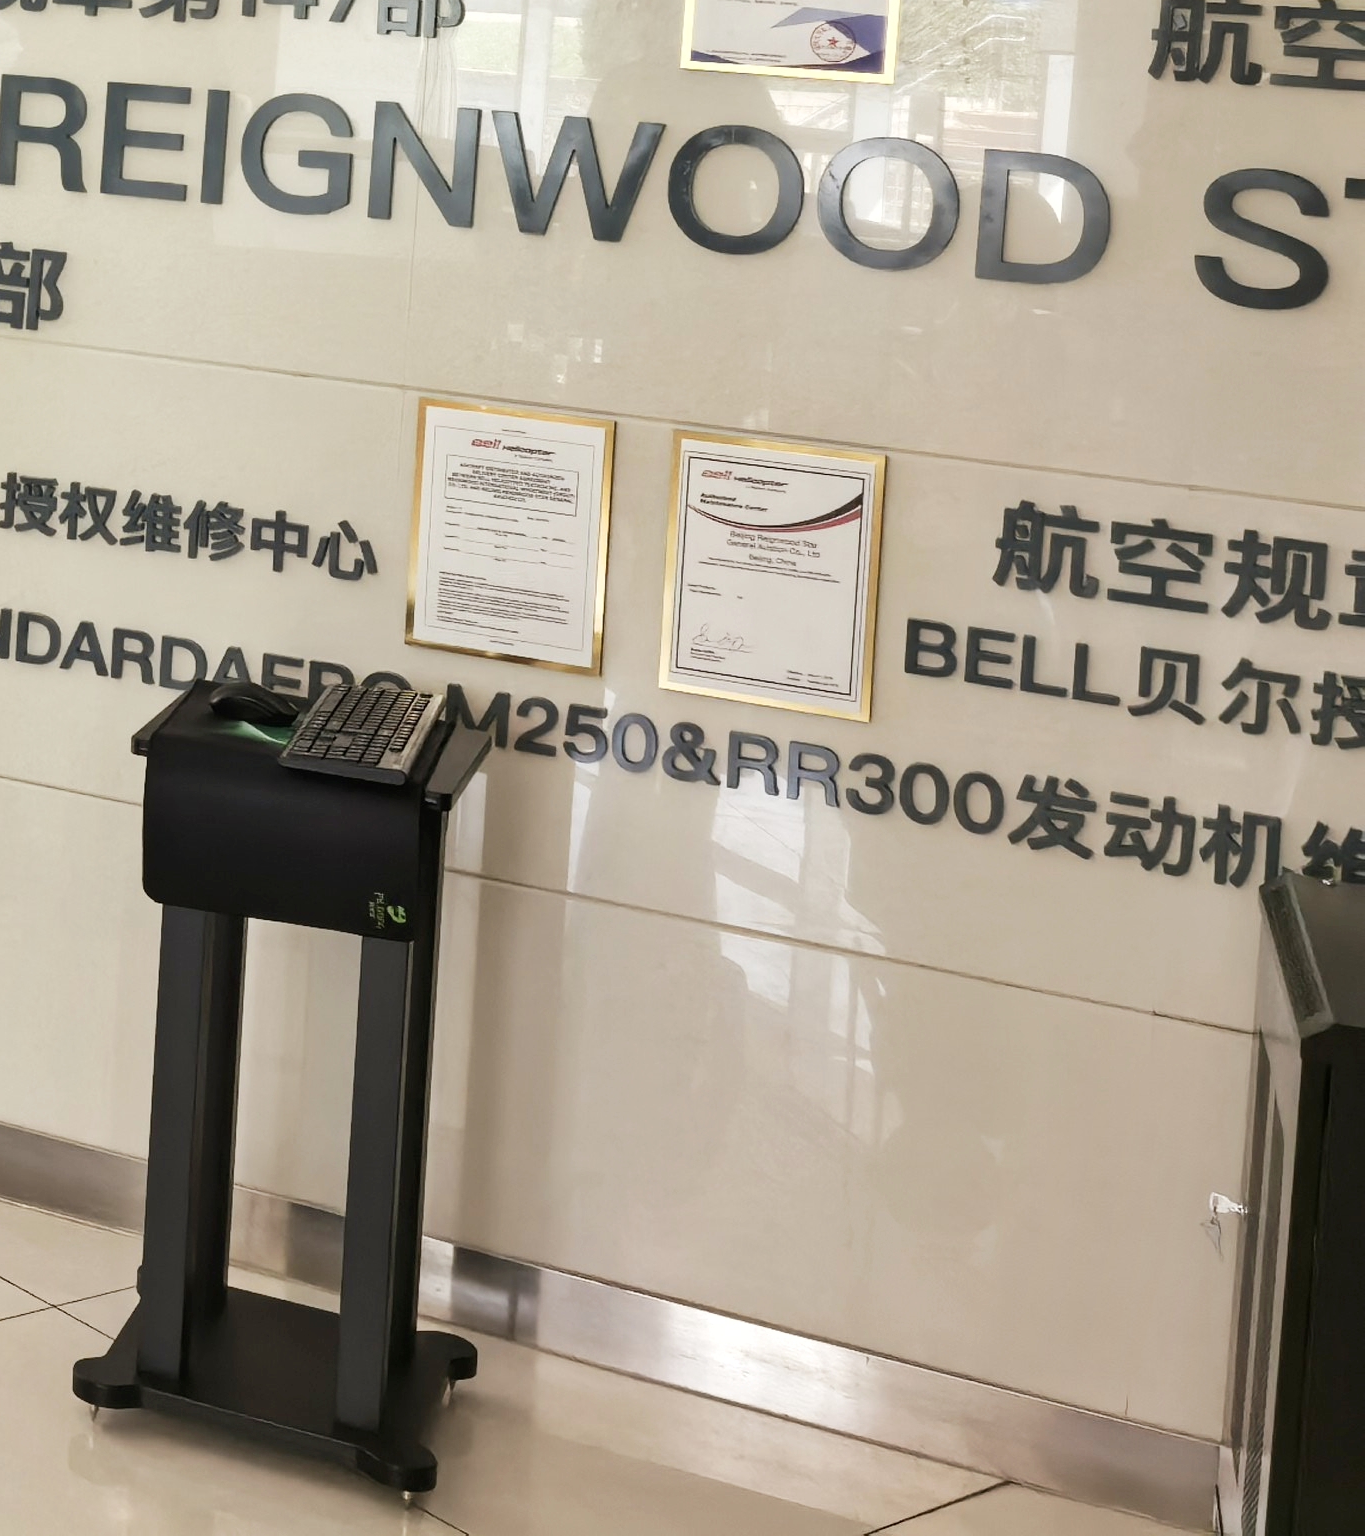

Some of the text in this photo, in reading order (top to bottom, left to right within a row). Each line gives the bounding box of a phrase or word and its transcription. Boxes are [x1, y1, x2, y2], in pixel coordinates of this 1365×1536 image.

[1194, 167, 1365, 310] S
[992, 500, 1365, 631] 航空规
